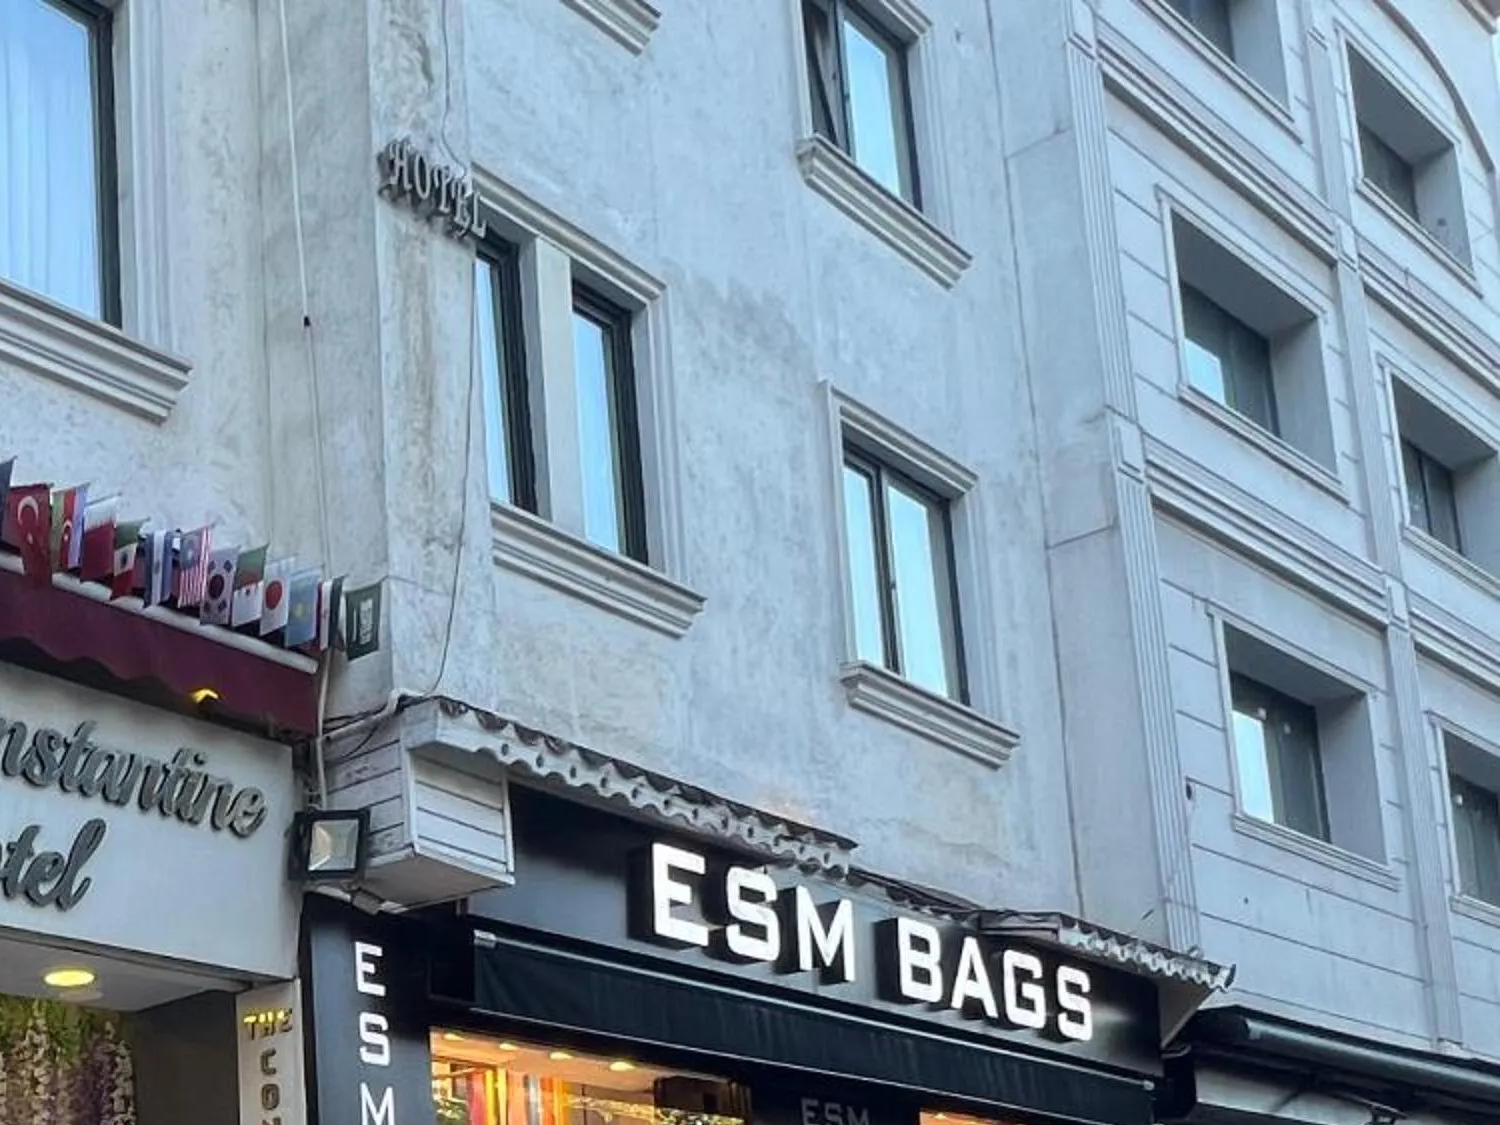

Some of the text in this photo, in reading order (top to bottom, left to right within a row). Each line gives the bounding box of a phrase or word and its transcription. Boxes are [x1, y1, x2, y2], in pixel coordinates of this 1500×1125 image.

[388, 142, 487, 239] HOTEL
[651, 842, 1094, 1042] ESM BAGS
[243, 1007, 294, 1042] THE
